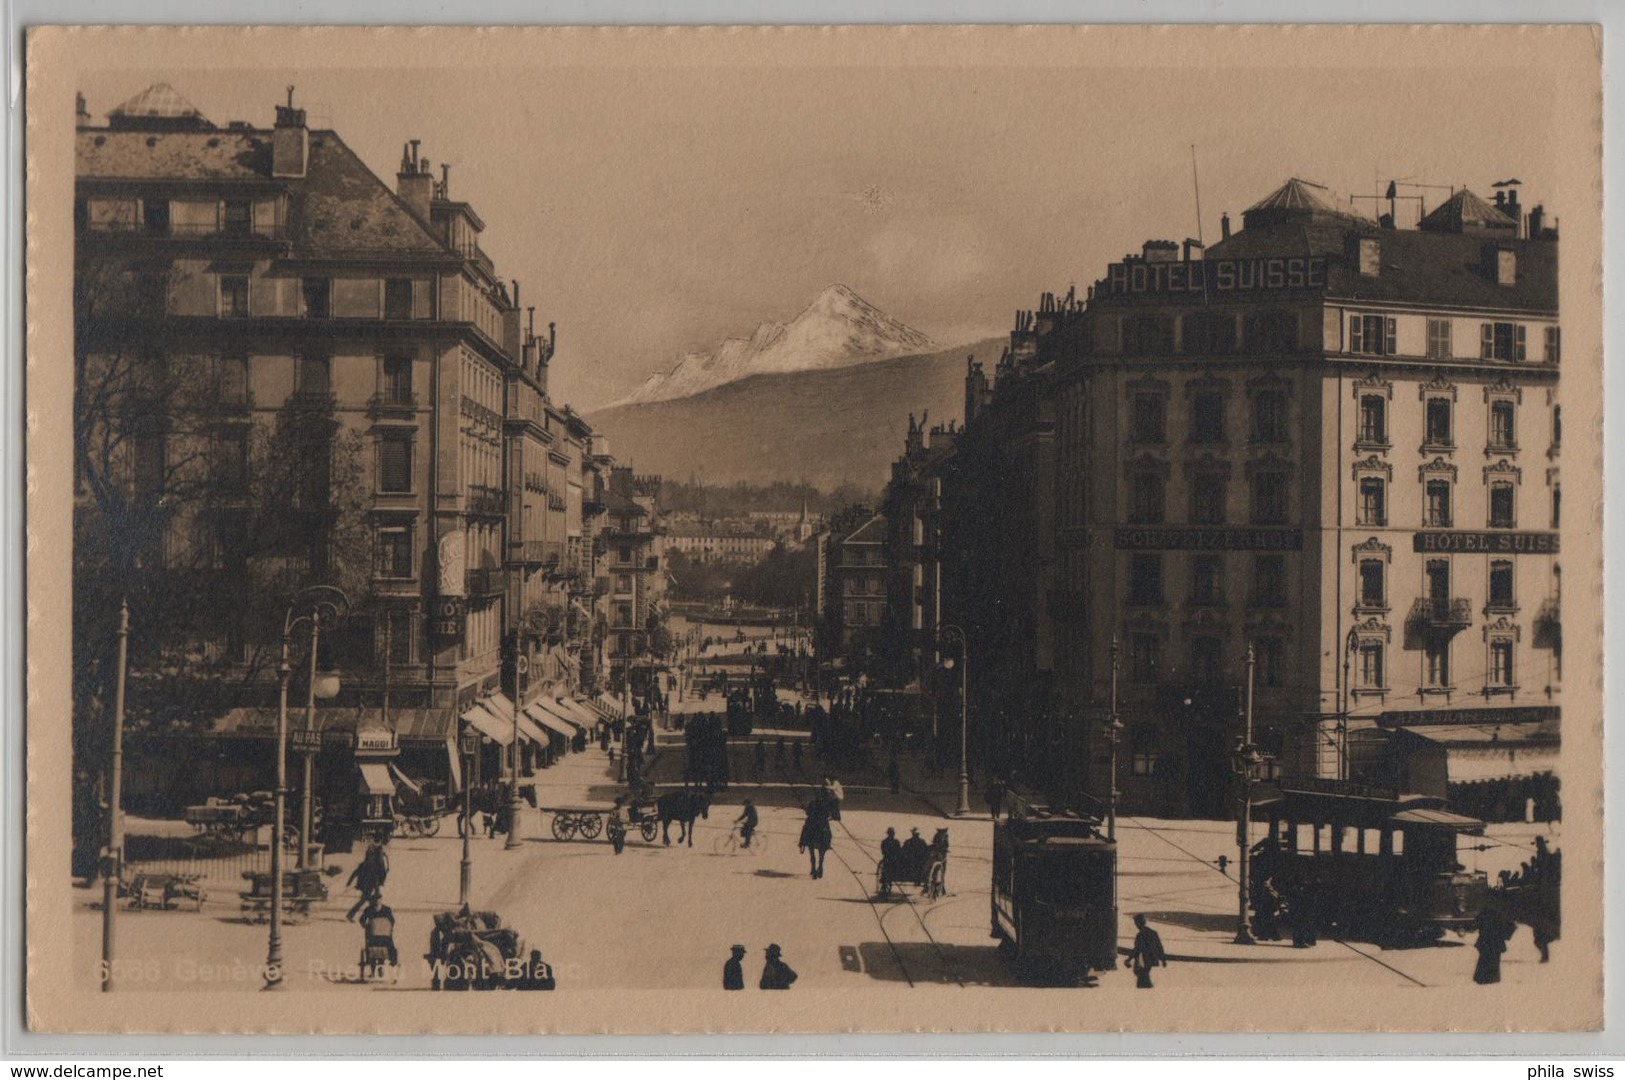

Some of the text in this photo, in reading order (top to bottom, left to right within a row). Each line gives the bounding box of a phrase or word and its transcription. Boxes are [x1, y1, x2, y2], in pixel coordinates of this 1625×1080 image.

[1110, 258, 1324, 293] HOTEL SUISSE
[1423, 533, 1489, 550] HOTEL
